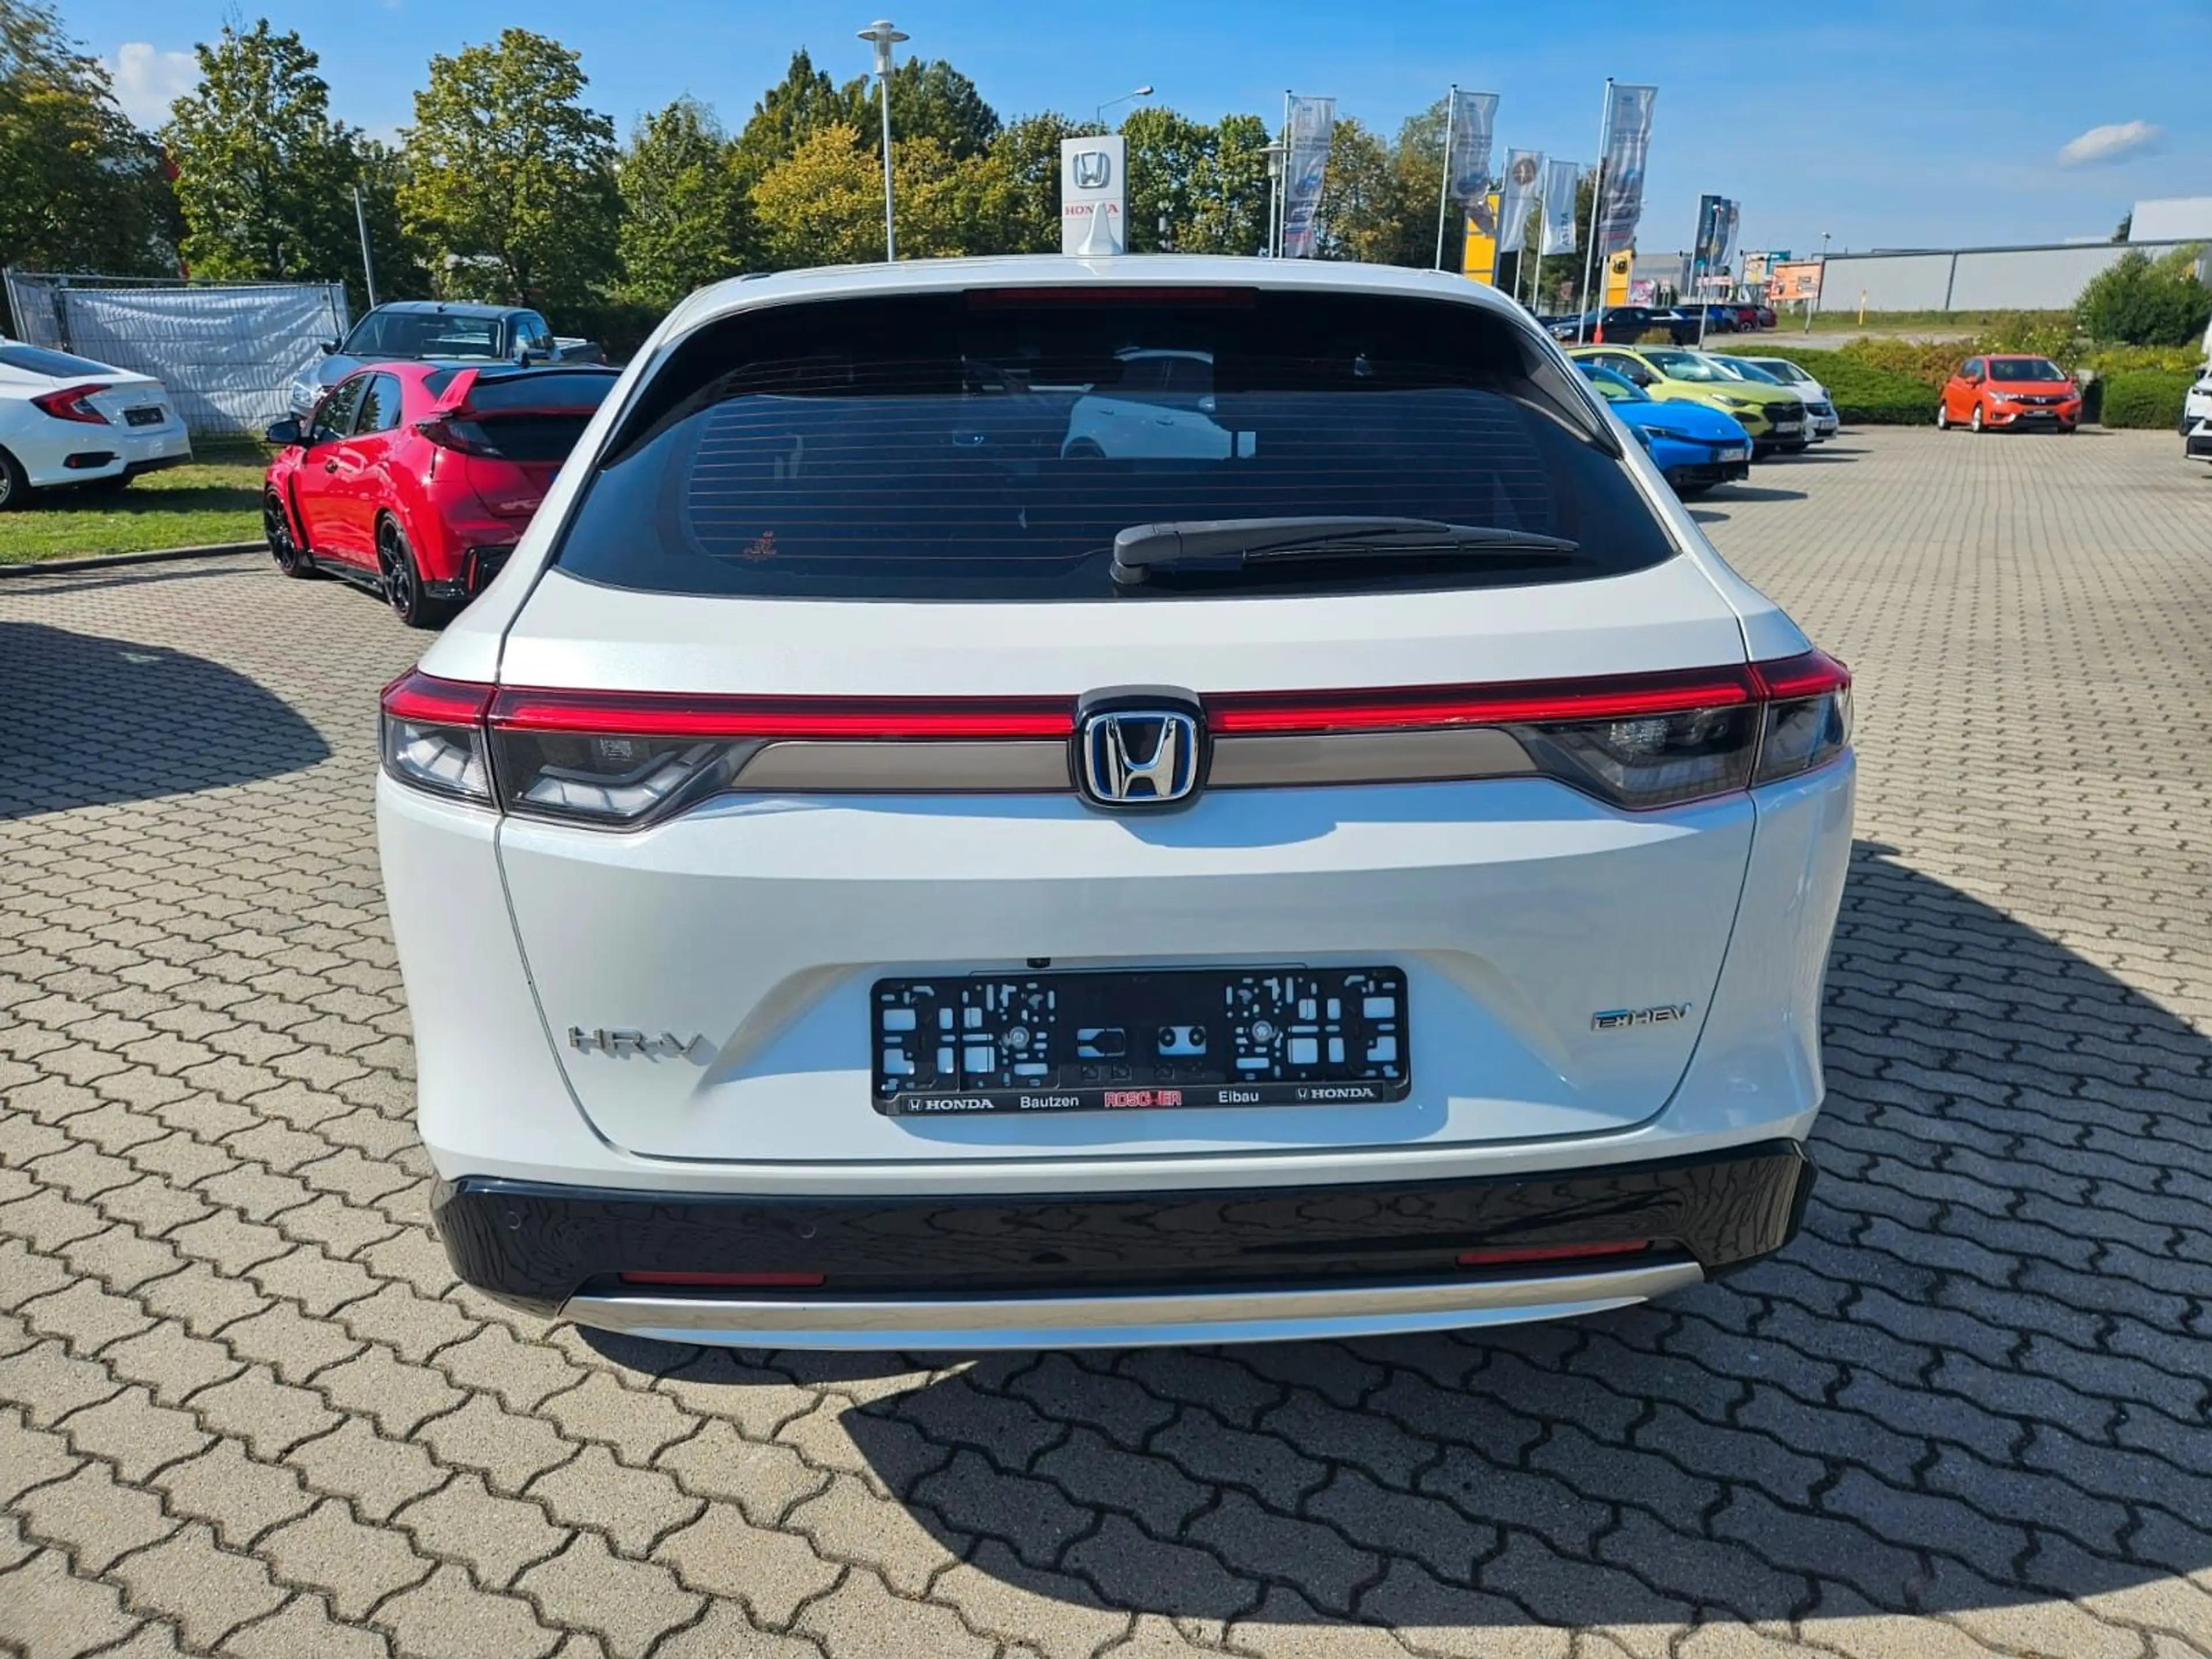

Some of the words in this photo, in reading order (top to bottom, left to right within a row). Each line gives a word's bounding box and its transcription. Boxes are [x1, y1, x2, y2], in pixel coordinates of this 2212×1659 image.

[1065, 203, 1119, 215] HONA
[1218, 1090, 1260, 1103] Eibau
[1311, 1087, 1377, 1099] HONDA
[925, 1098, 994, 1110] HONDA
[1020, 1095, 1080, 1109] Bautzen
